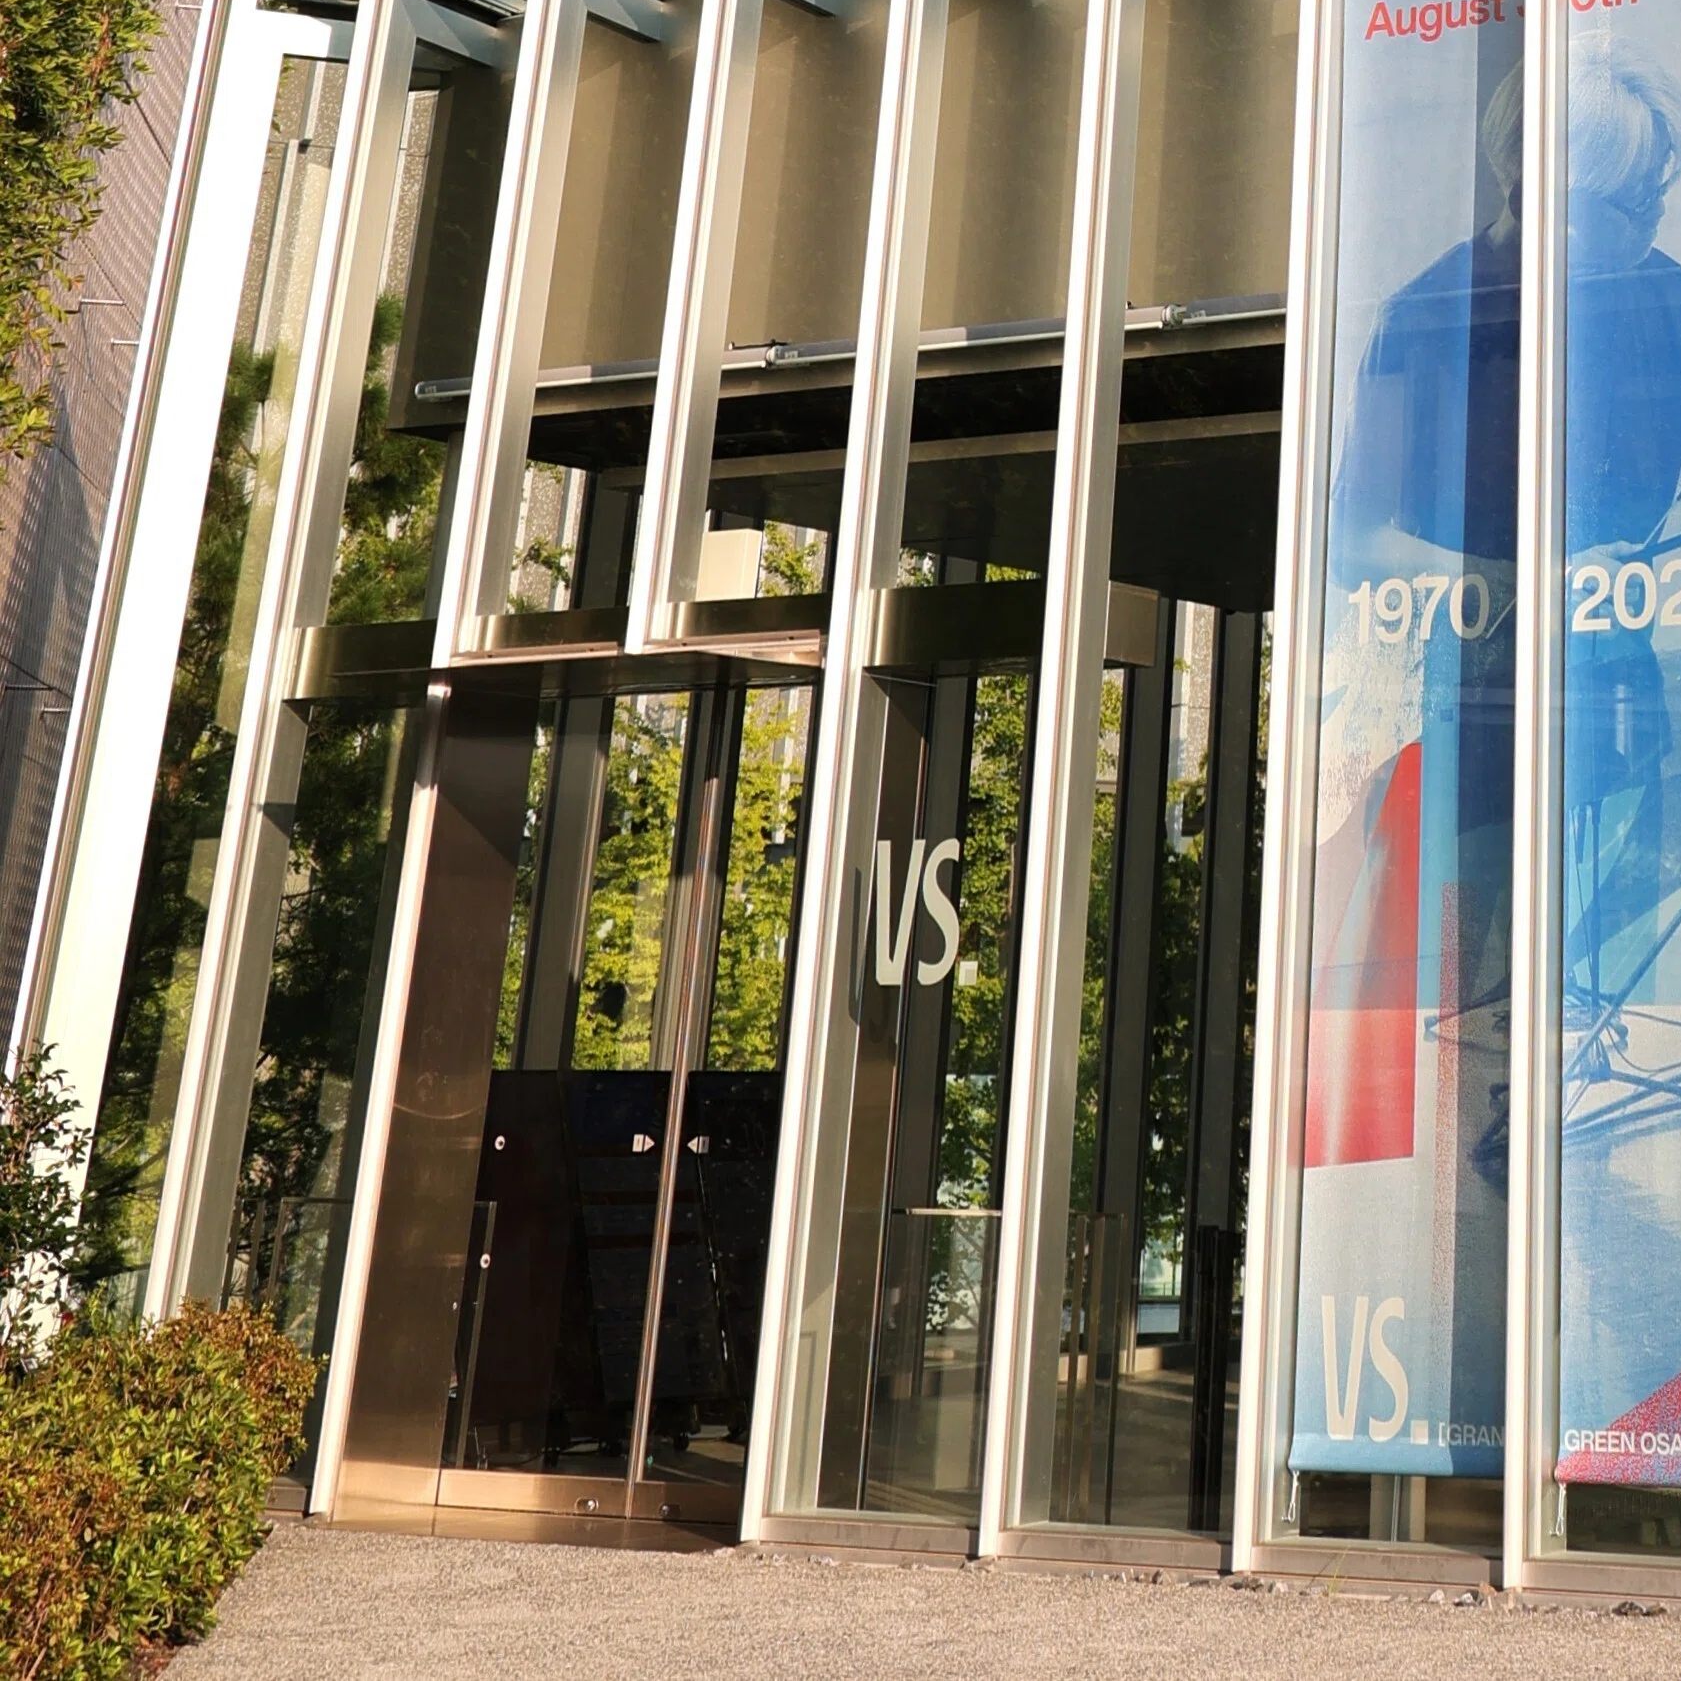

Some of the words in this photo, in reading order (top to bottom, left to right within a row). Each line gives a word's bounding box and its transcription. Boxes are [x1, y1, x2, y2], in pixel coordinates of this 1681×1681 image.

[876, 838, 978, 986] VS.
[1321, 1294, 1429, 1446] VS.
[1437, 1421, 1504, 1448] [GRAN
[1564, 1429, 1635, 1455] GREEN
